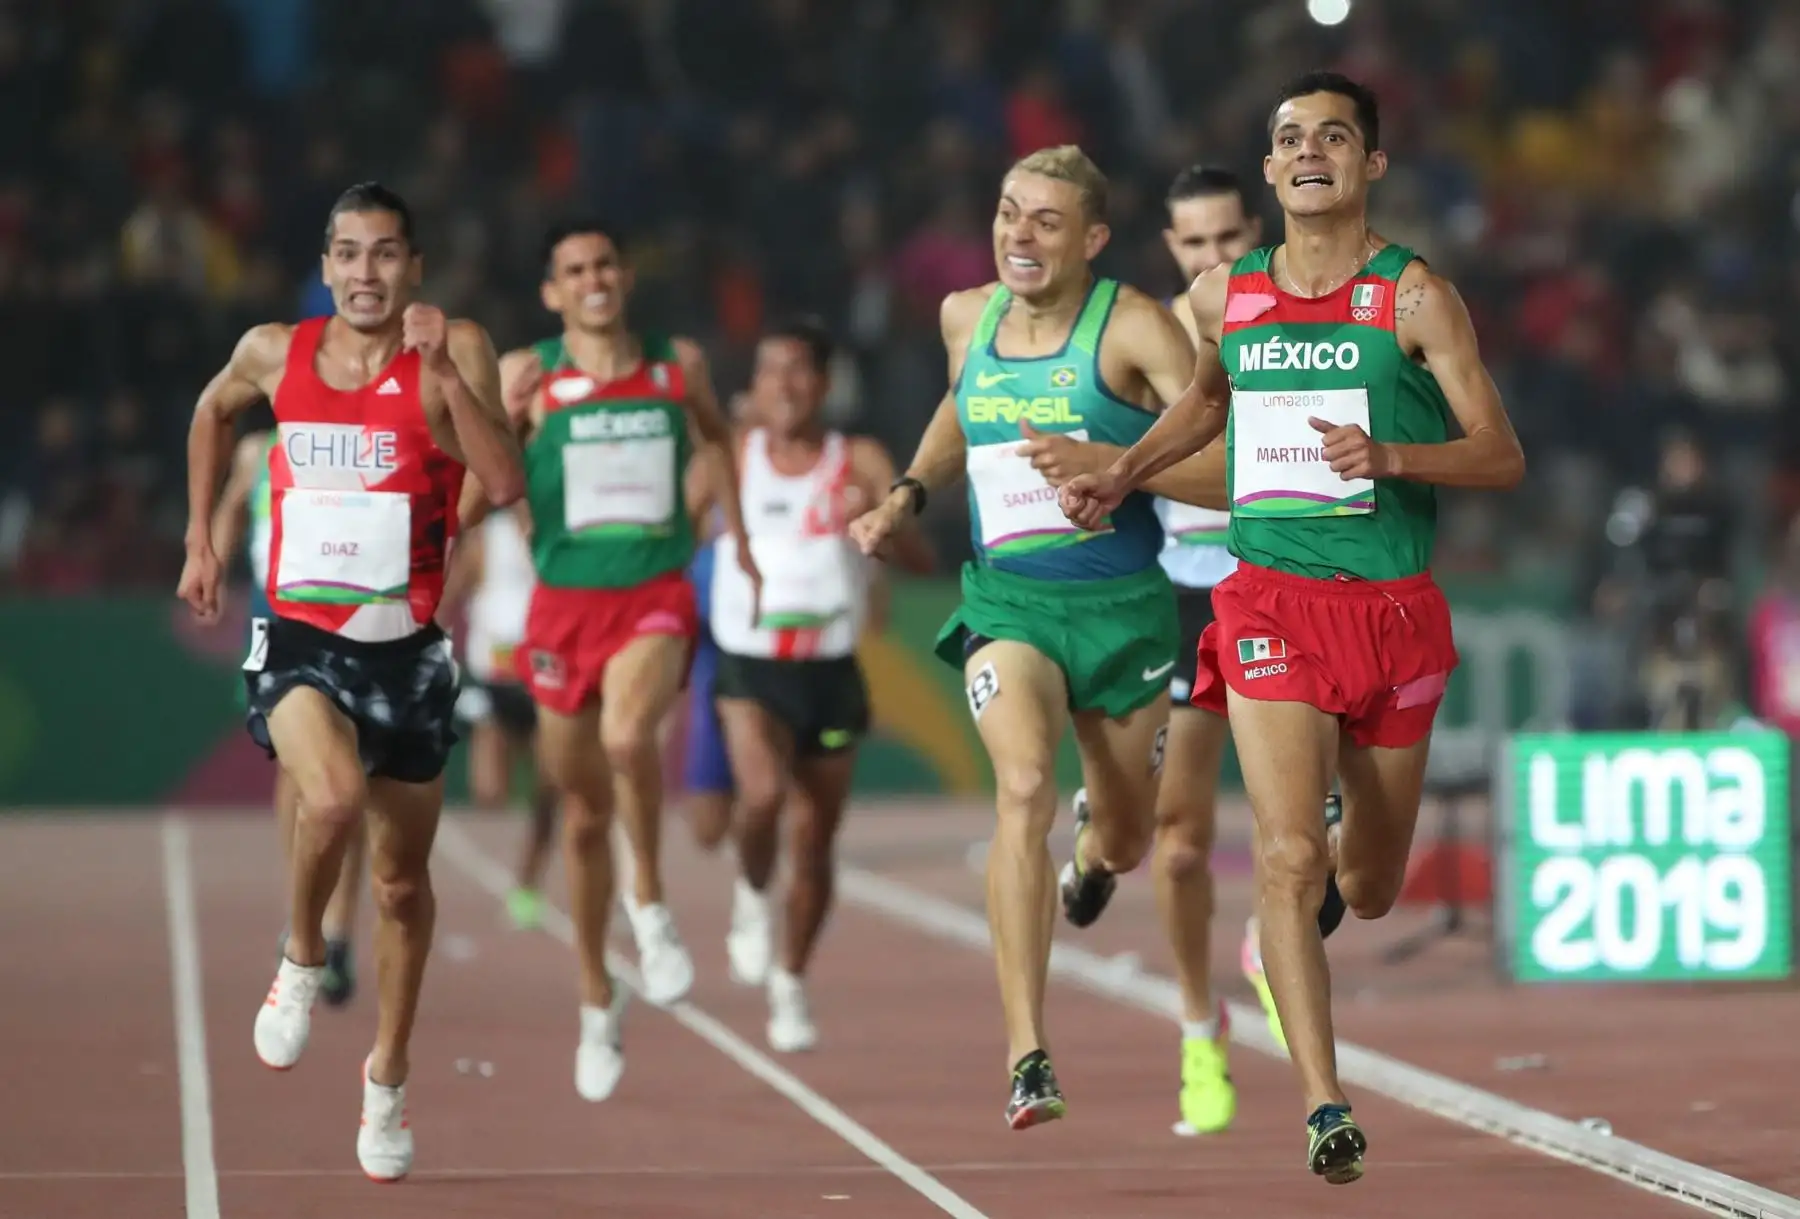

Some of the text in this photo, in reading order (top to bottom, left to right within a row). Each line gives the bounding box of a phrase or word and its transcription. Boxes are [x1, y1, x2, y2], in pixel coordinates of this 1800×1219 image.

[1239, 336, 1360, 372] MÉXICO
[967, 397, 1083, 424] BRASIL
[287, 431, 396, 470] CHILE
[1003, 486, 1056, 507] SANTO
[320, 541, 359, 556] DIAZ
[1244, 663, 1287, 680] MÉXICO
[1532, 853, 1767, 972] 2019
